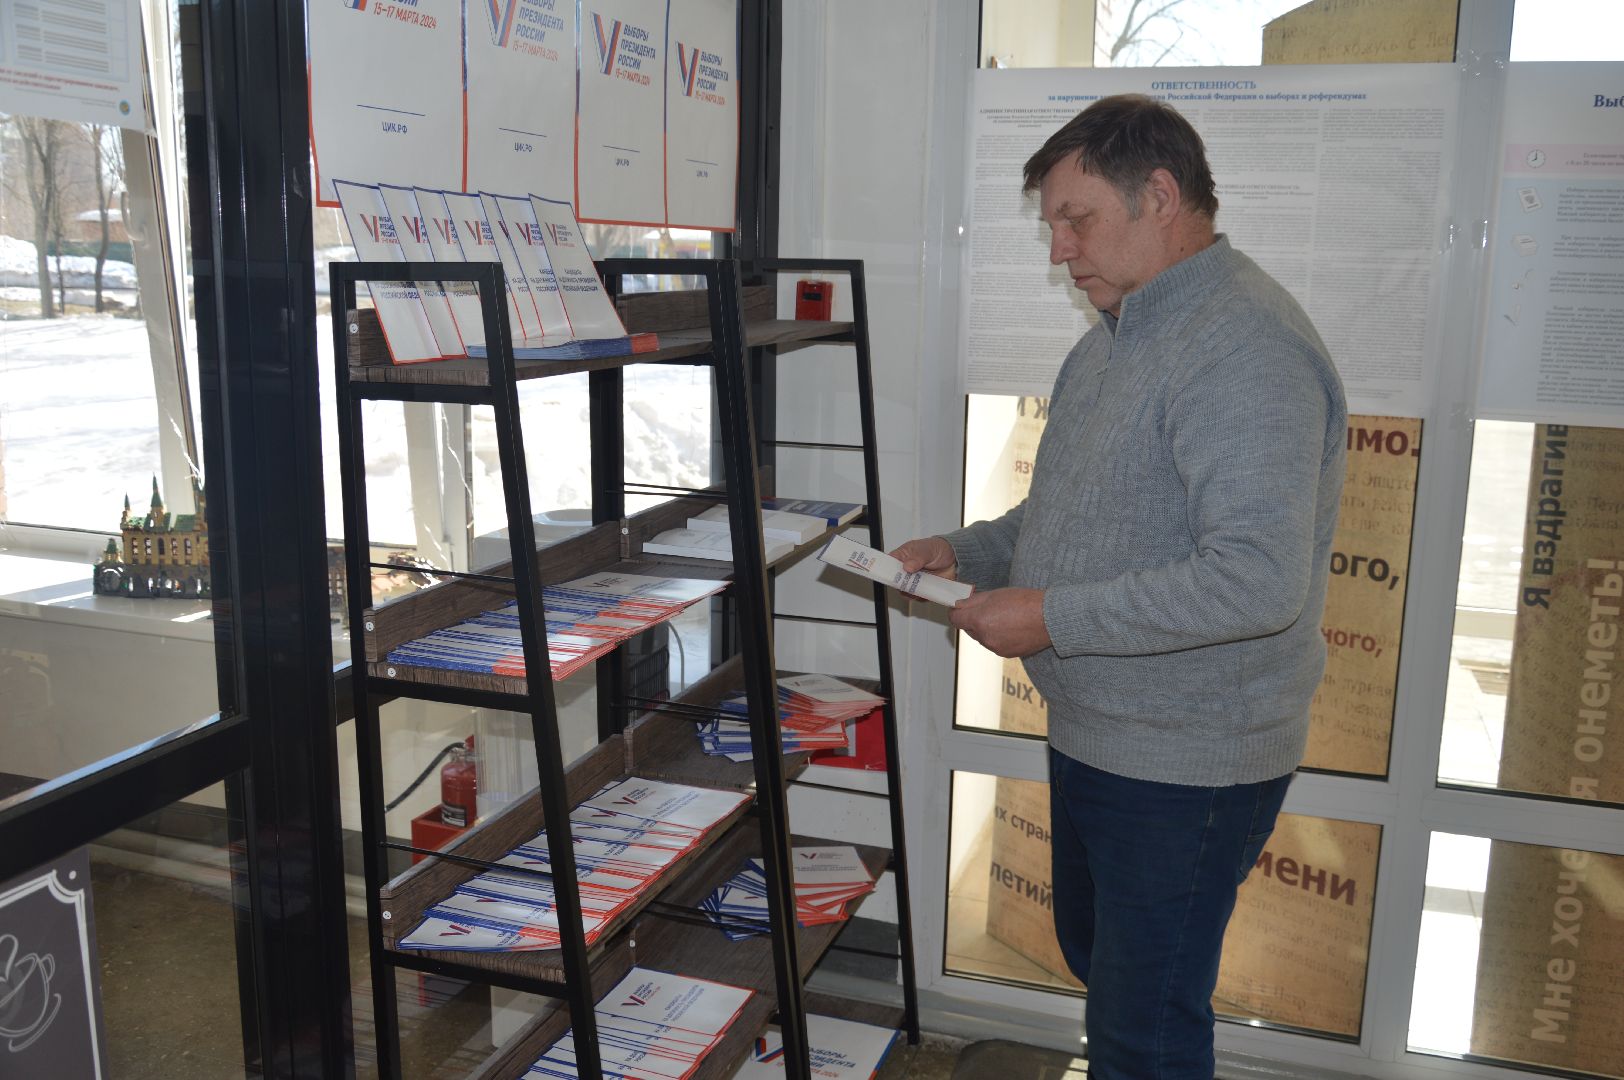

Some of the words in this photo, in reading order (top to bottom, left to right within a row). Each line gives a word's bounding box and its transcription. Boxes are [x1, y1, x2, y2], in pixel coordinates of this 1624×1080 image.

[395, 8, 419, 24] МАРТА
[419, 14, 437, 29] 2024
[519, 6, 563, 31] ПРЕЗИДЕНТА
[515, 23, 545, 43] РОССИИ
[623, 24, 650, 42] ВЫБОРЫ
[528, 45, 546, 58] МАРТА
[620, 39, 656, 60] ПРЕЗИДЕНТА
[617, 54, 642, 70] РОССИИ
[700, 51, 723, 66] ВЫБОРЫ
[698, 64, 729, 82] ПРЕЗИДЕНТА
[696, 77, 717, 91] РОССИИ
[1151, 81, 1257, 90] ОТВЕТСТВЕННОСТЬ
[1057, 95, 1099, 103] нарушение
[1213, 93, 1257, 101] Федерации
[1265, 93, 1299, 101] выборах
[1308, 93, 1366, 102] референдумах
[382, 121, 408, 135] ЦИК.РФ
[514, 142, 533, 153] ЦИК.РФ
[1523, 587, 1551, 610] Я
[1531, 958, 1576, 1044] Мне
